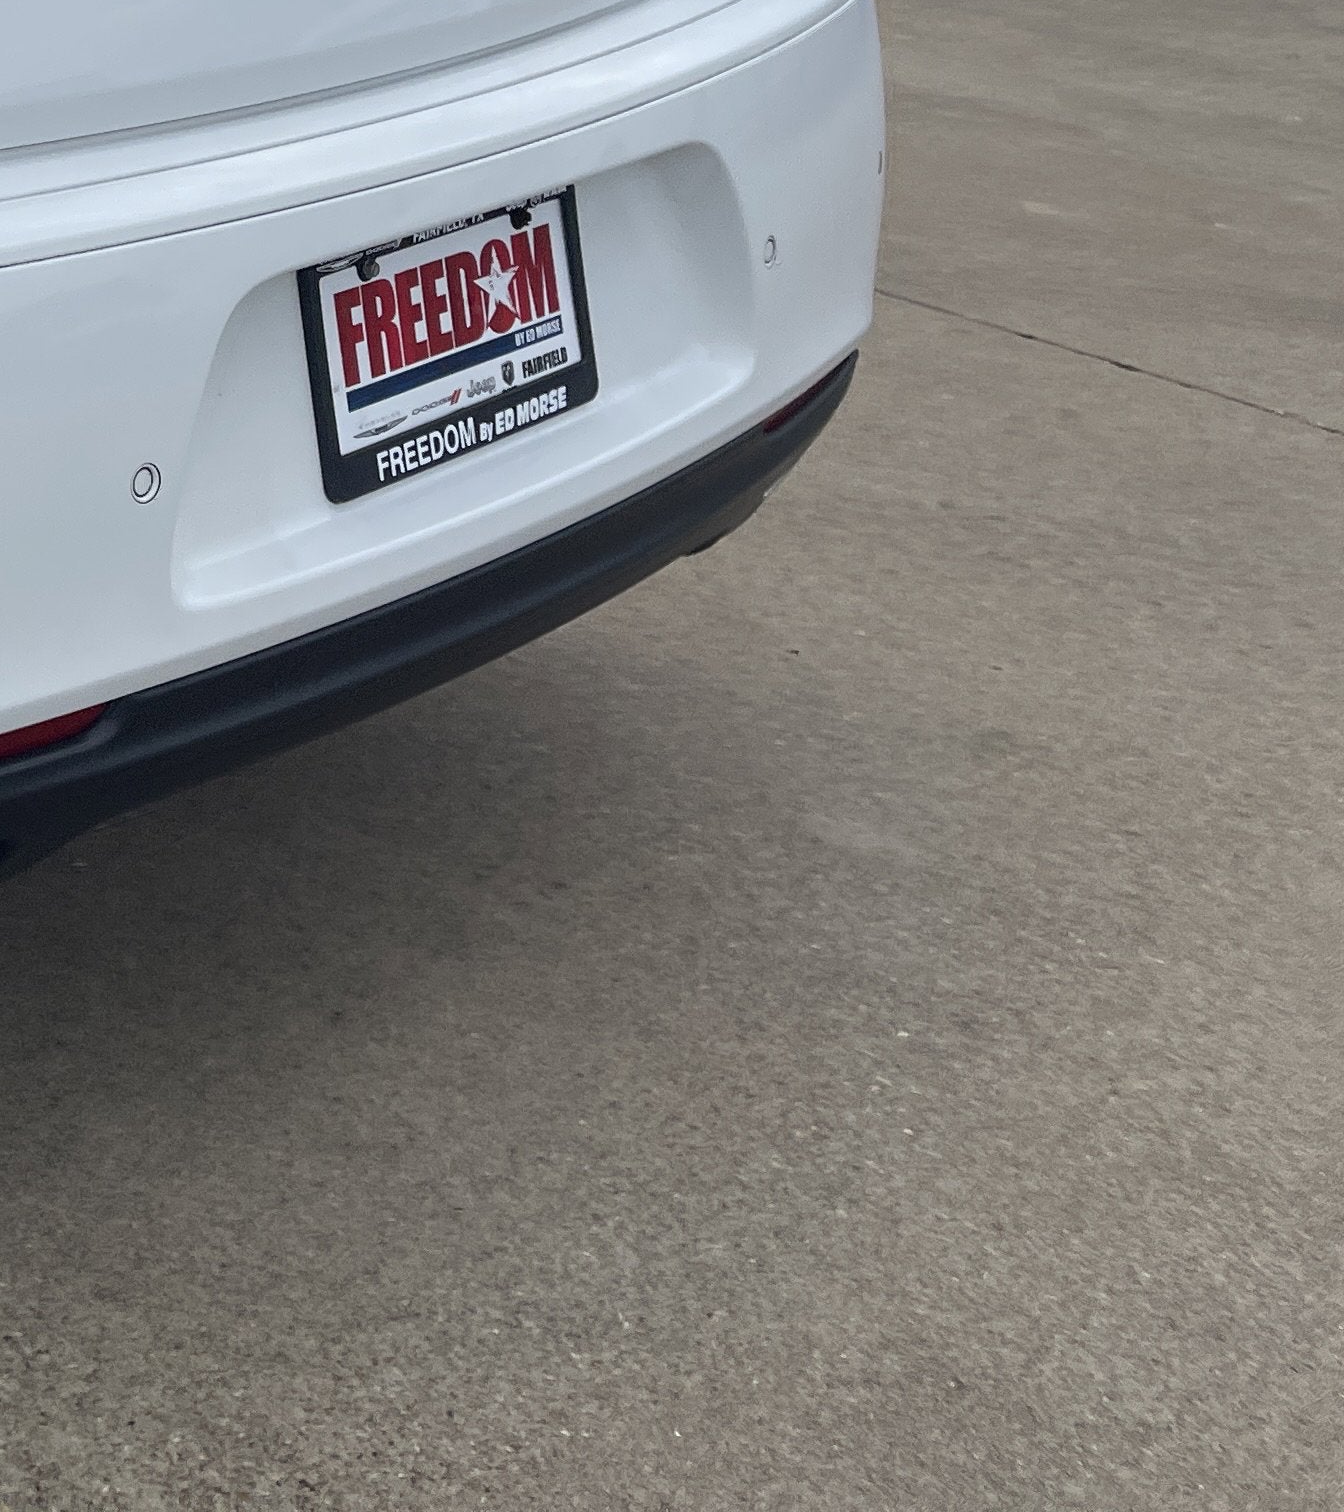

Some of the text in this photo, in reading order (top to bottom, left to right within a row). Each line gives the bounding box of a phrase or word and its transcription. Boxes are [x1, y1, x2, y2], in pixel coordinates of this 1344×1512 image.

[333, 224, 560, 387] FREEDOM
[522, 347, 568, 379] FAIRFIELD
[376, 416, 476, 482] FREEDOM
[495, 407, 515, 435] ED
[517, 386, 567, 426] MORSE
